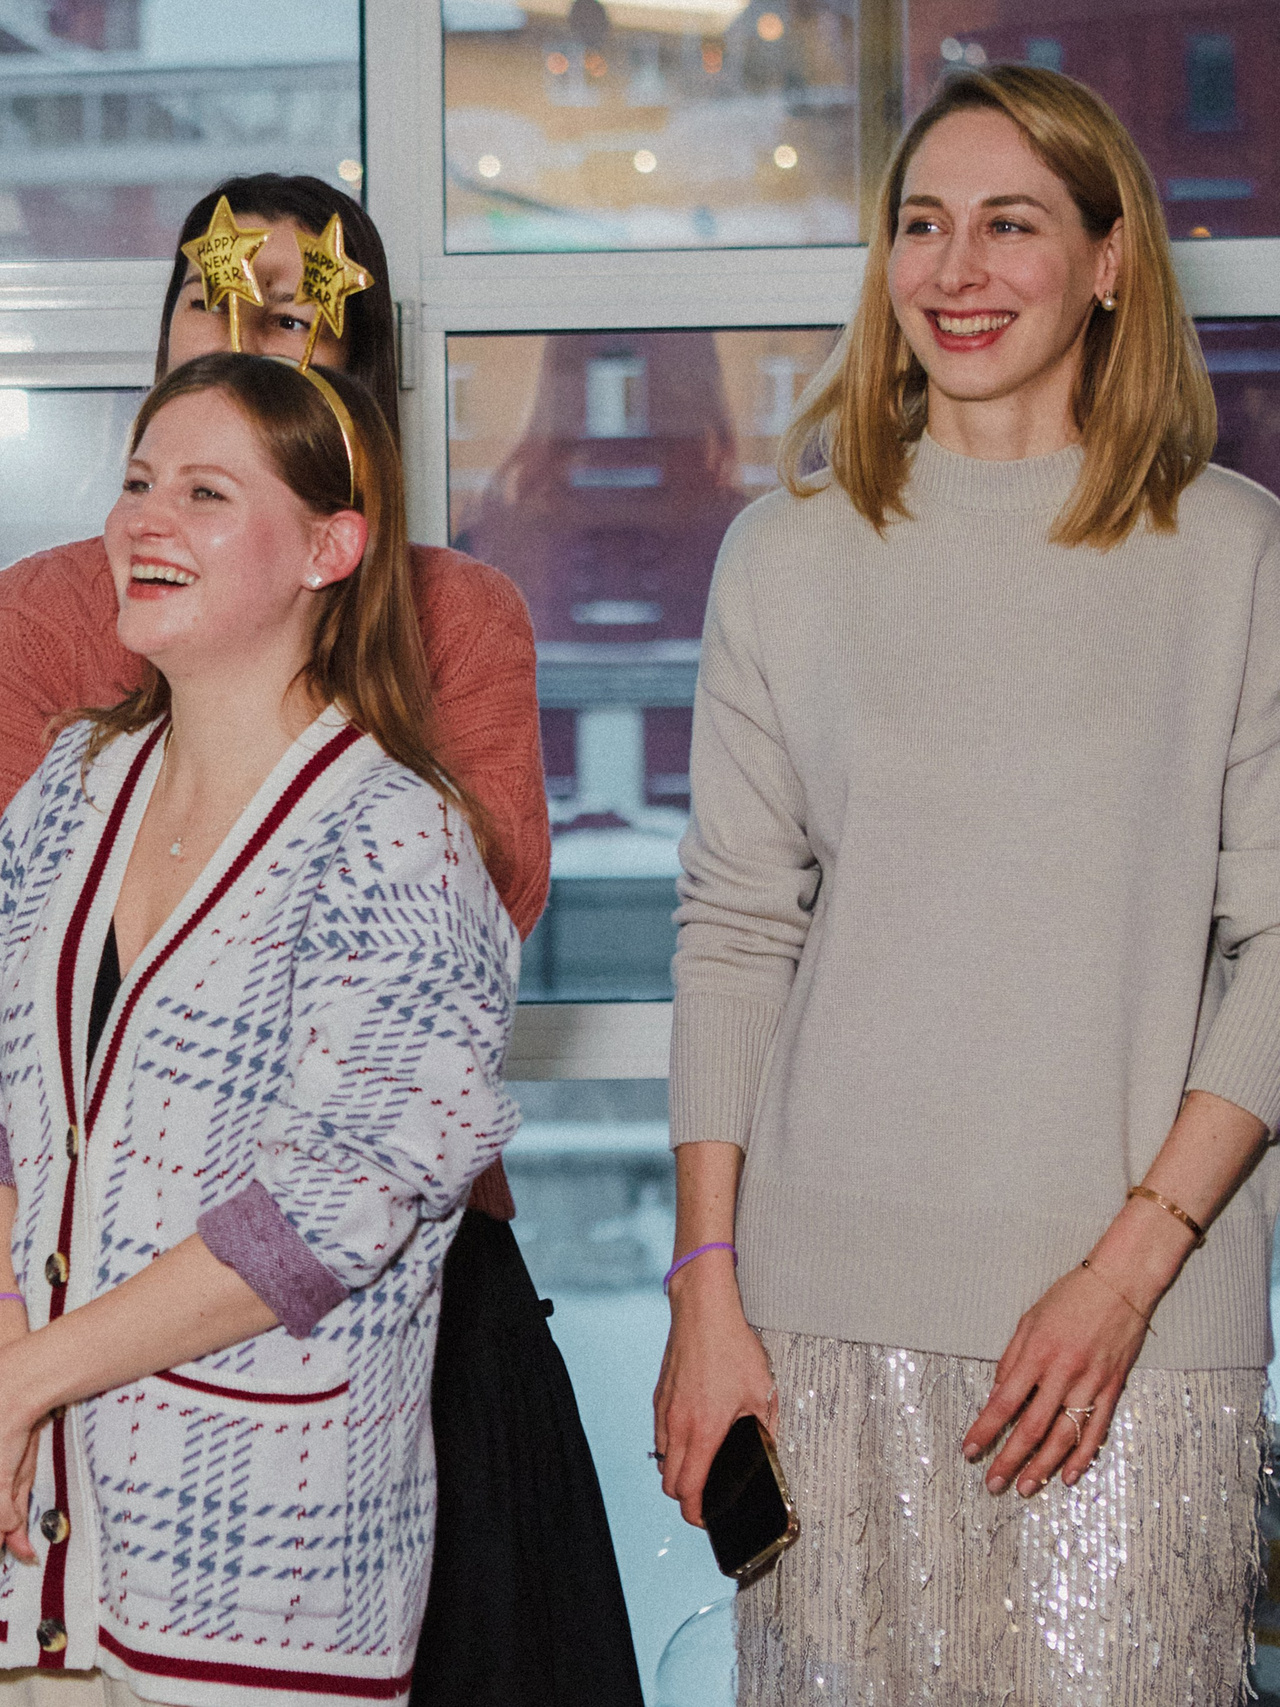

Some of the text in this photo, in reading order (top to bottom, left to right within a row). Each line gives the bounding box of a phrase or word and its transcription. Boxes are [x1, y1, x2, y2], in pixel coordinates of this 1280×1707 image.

[197, 235, 239, 256] HAPPY
[204, 253, 232, 269] NEW
[304, 251, 344, 276] HAPPY
[305, 266, 332, 286] NEW
[303, 281, 331, 307] YEAR
